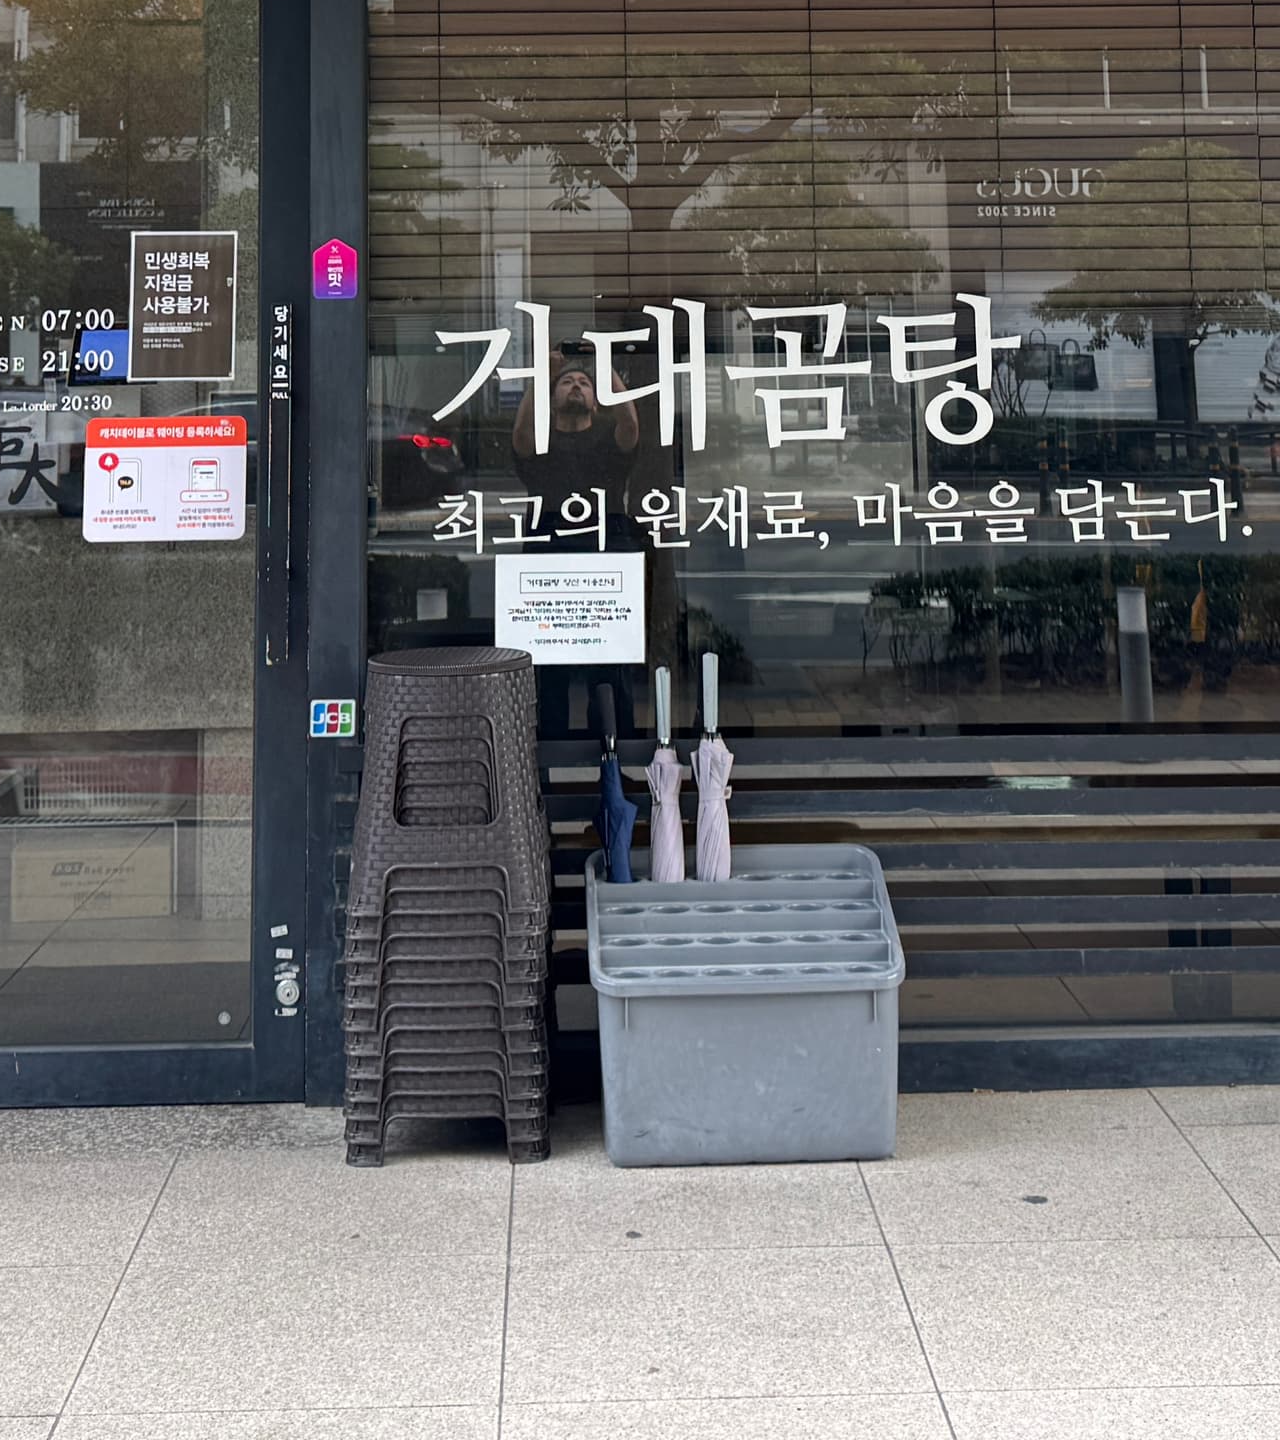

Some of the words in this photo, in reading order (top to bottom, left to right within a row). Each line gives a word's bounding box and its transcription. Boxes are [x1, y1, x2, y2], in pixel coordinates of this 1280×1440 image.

[144, 252, 210, 270] 민생회복
[144, 274, 193, 292] 지원금
[328, 273, 342, 287] 맛
[143, 296, 209, 314] 사용불가
[41, 309, 115, 331] 07:00
[273, 305, 288, 378] 당기세요
[42, 350, 114, 372] 21:00
[432, 292, 1022, 455] 거대곰탕
[28, 400, 57, 411] order
[61, 395, 112, 411] 20:30
[157, 426, 185, 438] 웨이팅
[432, 487, 607, 555] 최고의
[634, 485, 830, 551] 원재료,
[852, 479, 1035, 547] 마음을
[1055, 477, 1253, 543] 담는다.
[311, 712, 351, 725] JCB
